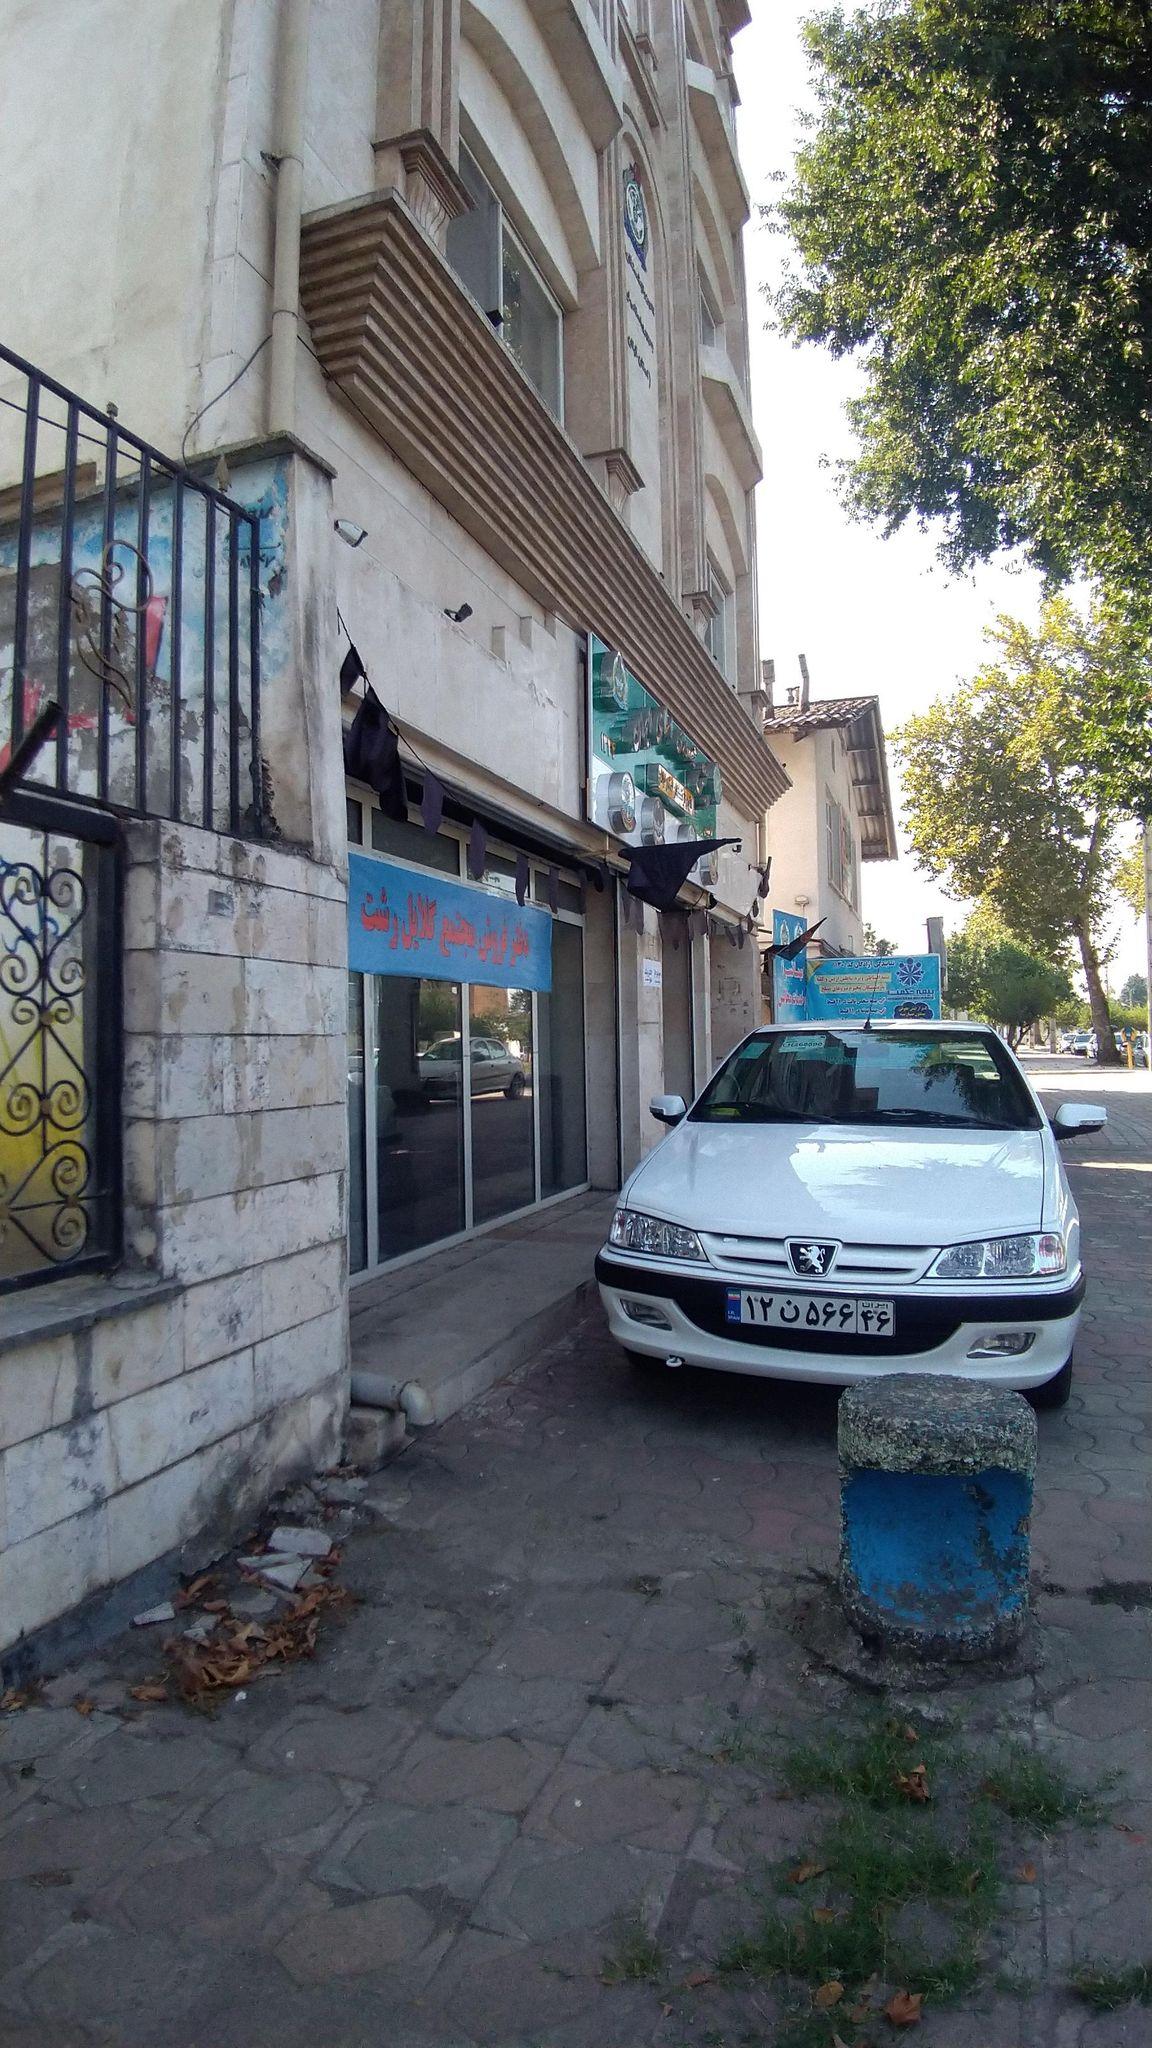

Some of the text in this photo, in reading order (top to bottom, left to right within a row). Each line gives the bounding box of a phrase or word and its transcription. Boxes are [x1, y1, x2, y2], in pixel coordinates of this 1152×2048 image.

[360, 886, 529, 967] دفتر فروش مجتمع گلایل رشت
[746, 1295, 854, 1328] ۱۲ ن ۵۶۶
[860, 1309, 891, 1332] ۴۶
